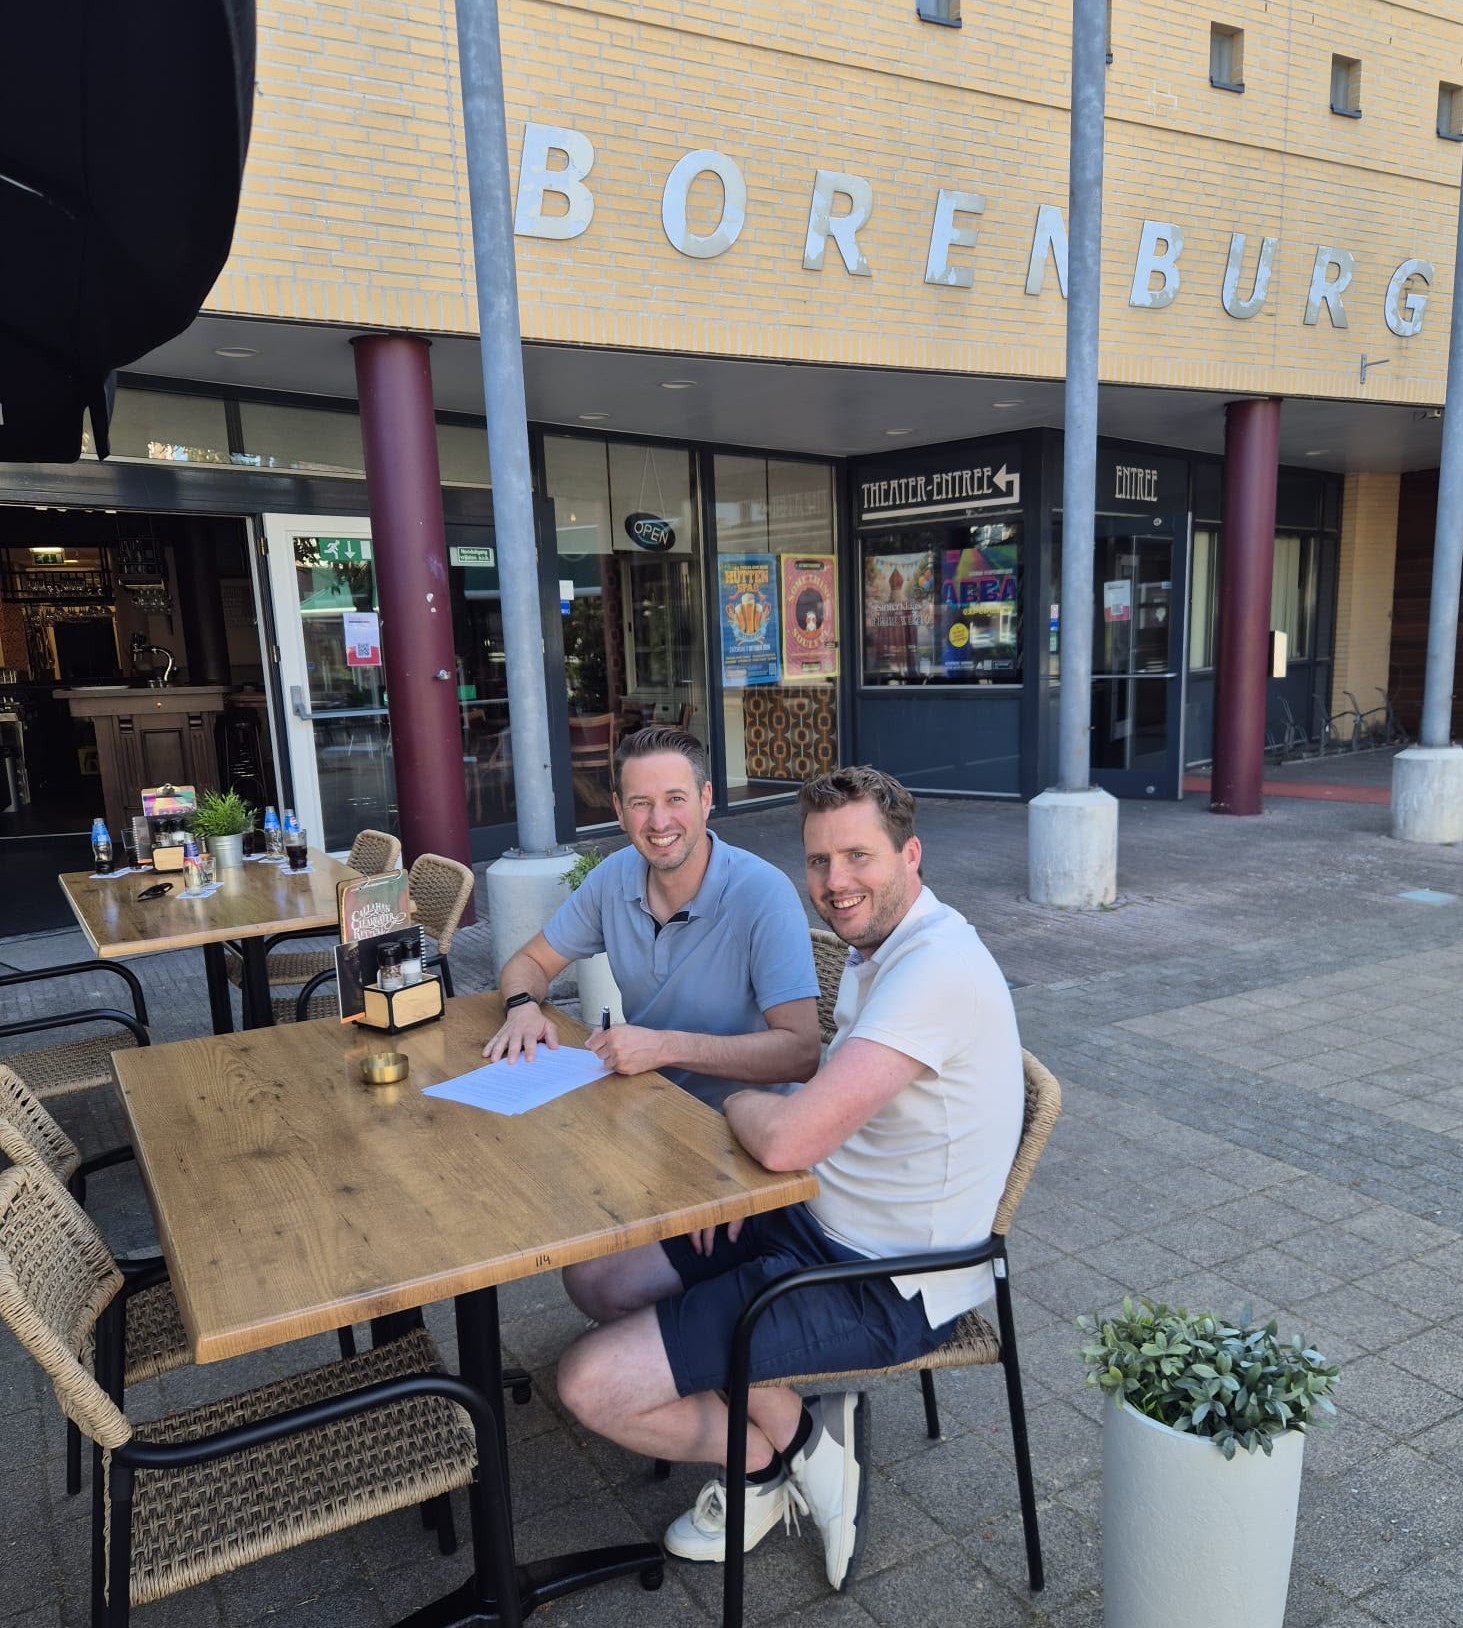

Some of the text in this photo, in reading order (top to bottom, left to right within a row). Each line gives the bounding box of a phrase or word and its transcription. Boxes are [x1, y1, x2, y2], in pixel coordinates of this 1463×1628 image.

[513, 121, 1435, 338] BORENBURG
[862, 466, 993, 509] THEATER-ENTREE
[1115, 465, 1158, 502] ENTREE
[633, 520, 669, 546] OPEN
[942, 575, 1017, 605] ABBA
[535, 1254, 551, 1268] 114
